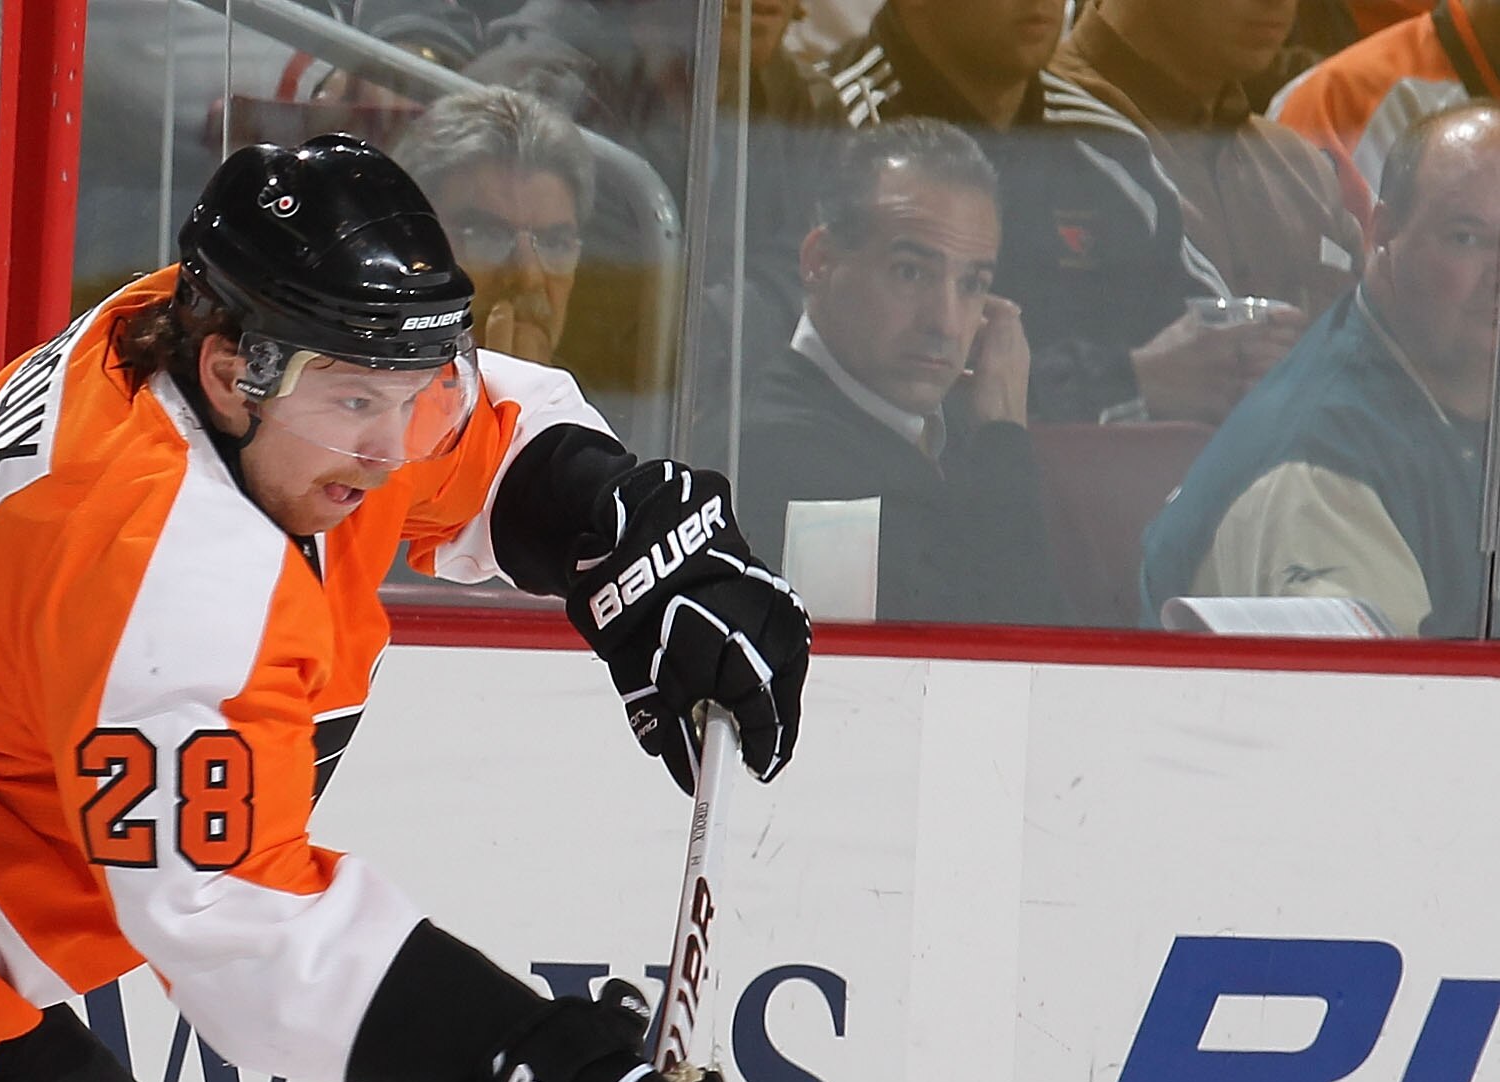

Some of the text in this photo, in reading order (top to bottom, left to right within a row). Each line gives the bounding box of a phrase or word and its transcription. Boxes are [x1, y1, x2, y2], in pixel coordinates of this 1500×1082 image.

[401, 310, 465, 331] BAUER
[589, 494, 726, 630] BAUER
[76, 727, 254, 871] 28
